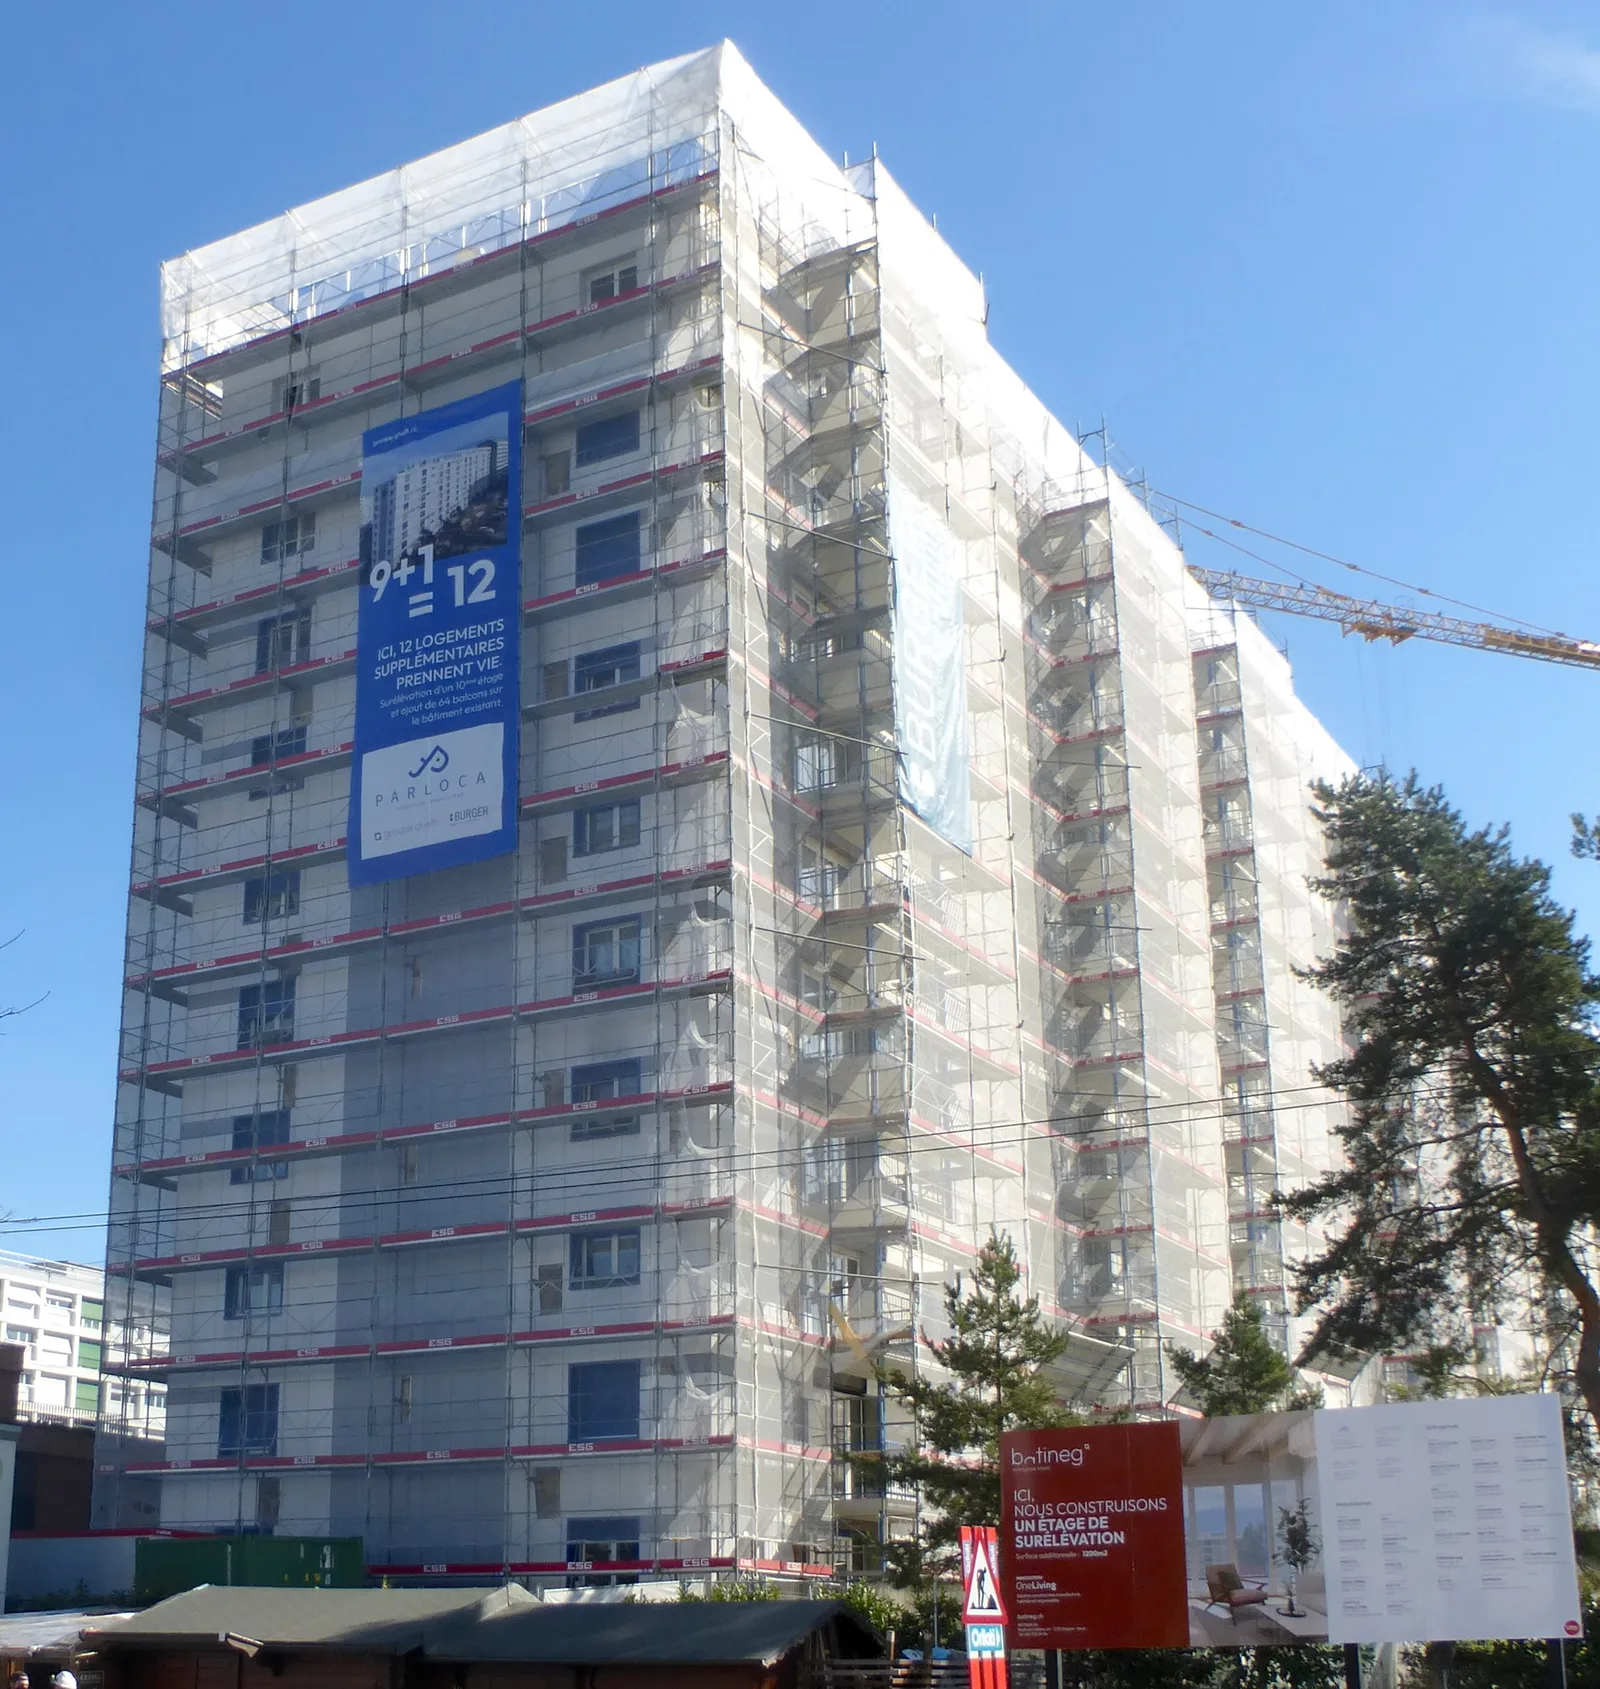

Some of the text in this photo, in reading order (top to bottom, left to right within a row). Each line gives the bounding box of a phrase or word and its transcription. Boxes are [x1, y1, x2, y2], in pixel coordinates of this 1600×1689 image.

[369, 544, 434, 603] 9+1
[447, 559, 496, 608] 12
[377, 618, 504, 661] ICI, 12 LOGEMENTS
[373, 637, 504, 680] SUPPLÉMENTAIRES
[396, 655, 502, 690] PRENNENT VIE.
[379, 688, 432, 709] Surélévation
[433, 684, 454, 695] d'un
[477, 673, 504, 686] étage
[400, 703, 423, 716] ajout
[424, 700, 437, 710] de
[438, 696, 450, 707] 64
[452, 690, 487, 704] balcons
[489, 686, 504, 695] sur
[411, 698, 504, 725] le bâtiment existant.
[375, 771, 486, 807] PARLOCA
[1011, 1447, 1083, 1466] batineg
[1013, 1489, 1035, 1503] ICI,
[1014, 1498, 1168, 1517] NOUS CONSTRUISONS
[1014, 1514, 1109, 1532] UN ÉTAGE DE
[1015, 1530, 1125, 1548] SURÉLÉVATION
[1016, 1581, 1057, 1591] OneLiving
